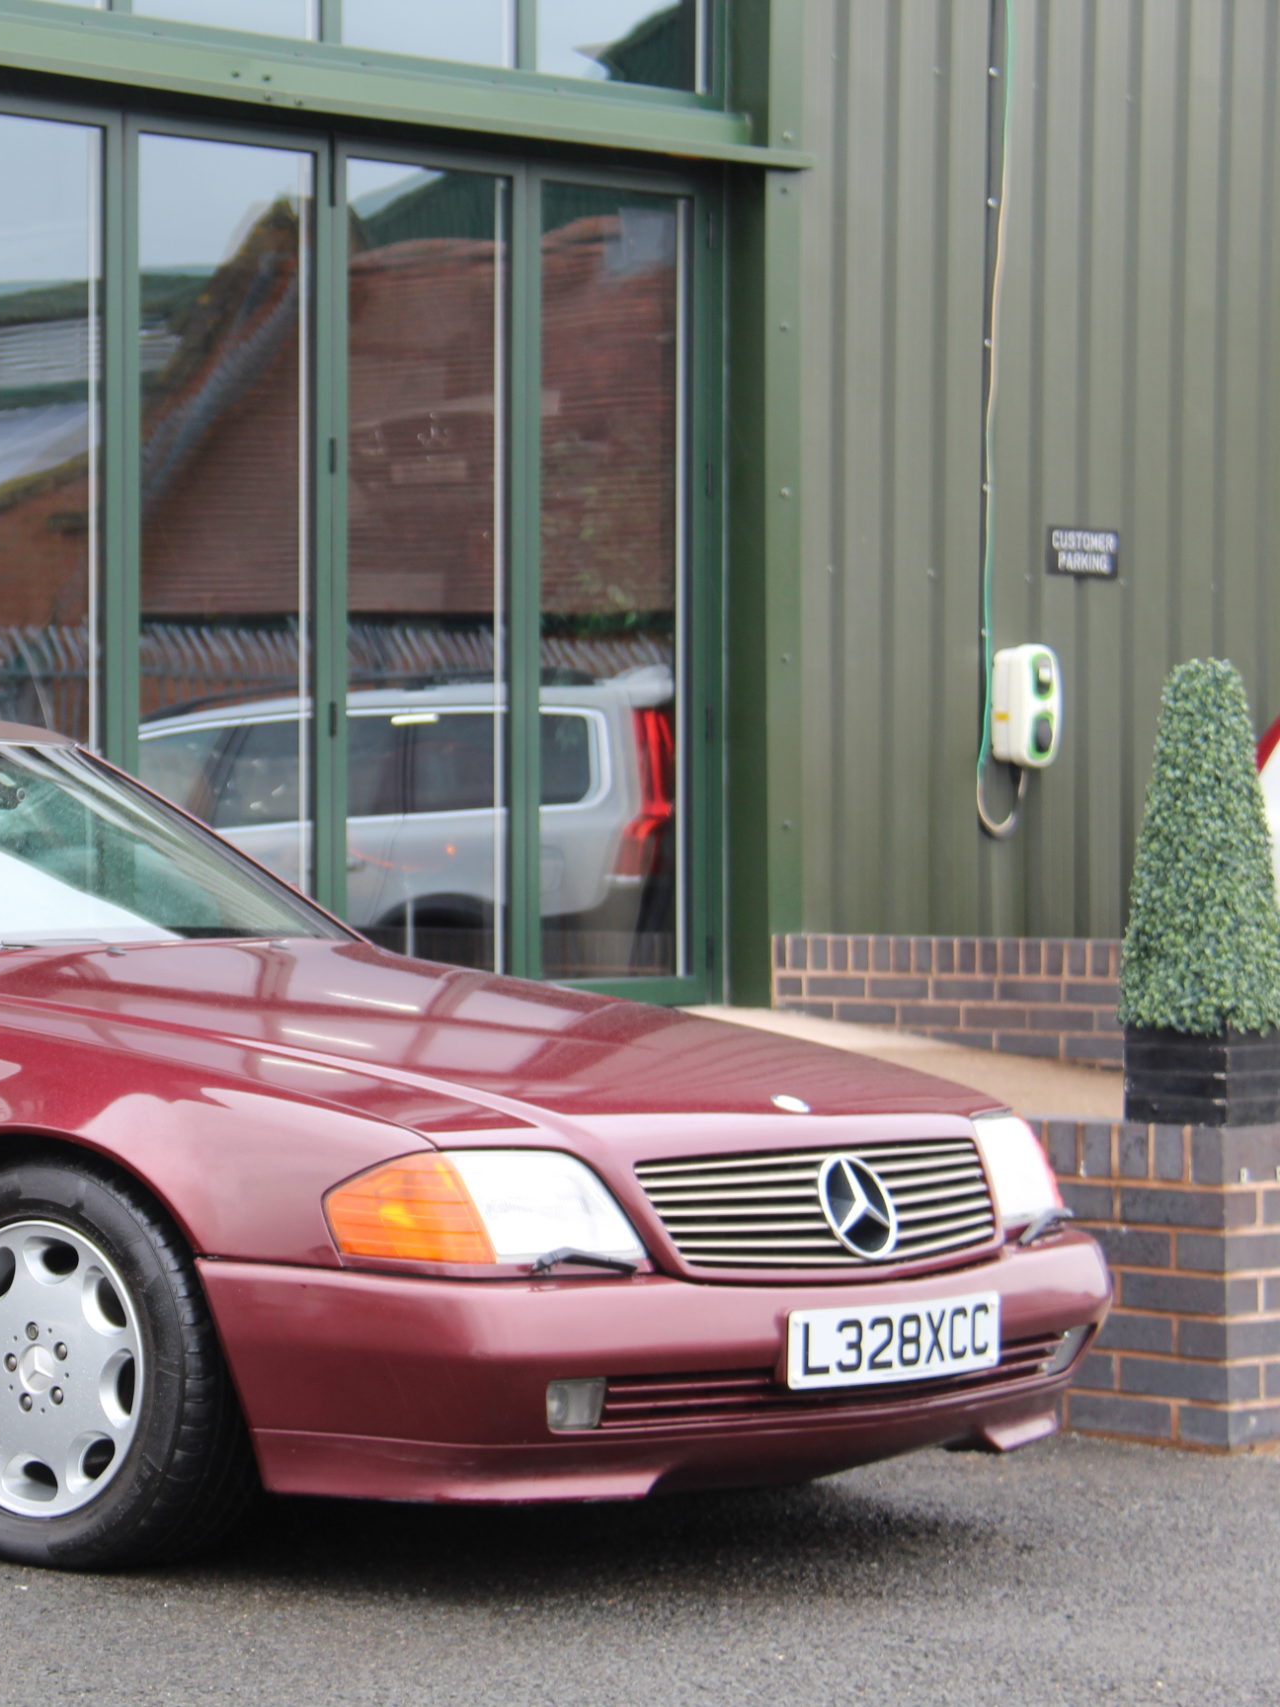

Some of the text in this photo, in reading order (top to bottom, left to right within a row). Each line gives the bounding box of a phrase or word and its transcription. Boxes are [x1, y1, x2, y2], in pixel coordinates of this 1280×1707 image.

[1051, 529, 1115, 553] CUSTOMER
[1057, 551, 1111, 575] PARKING
[802, 1304, 989, 1376] L328XCC
